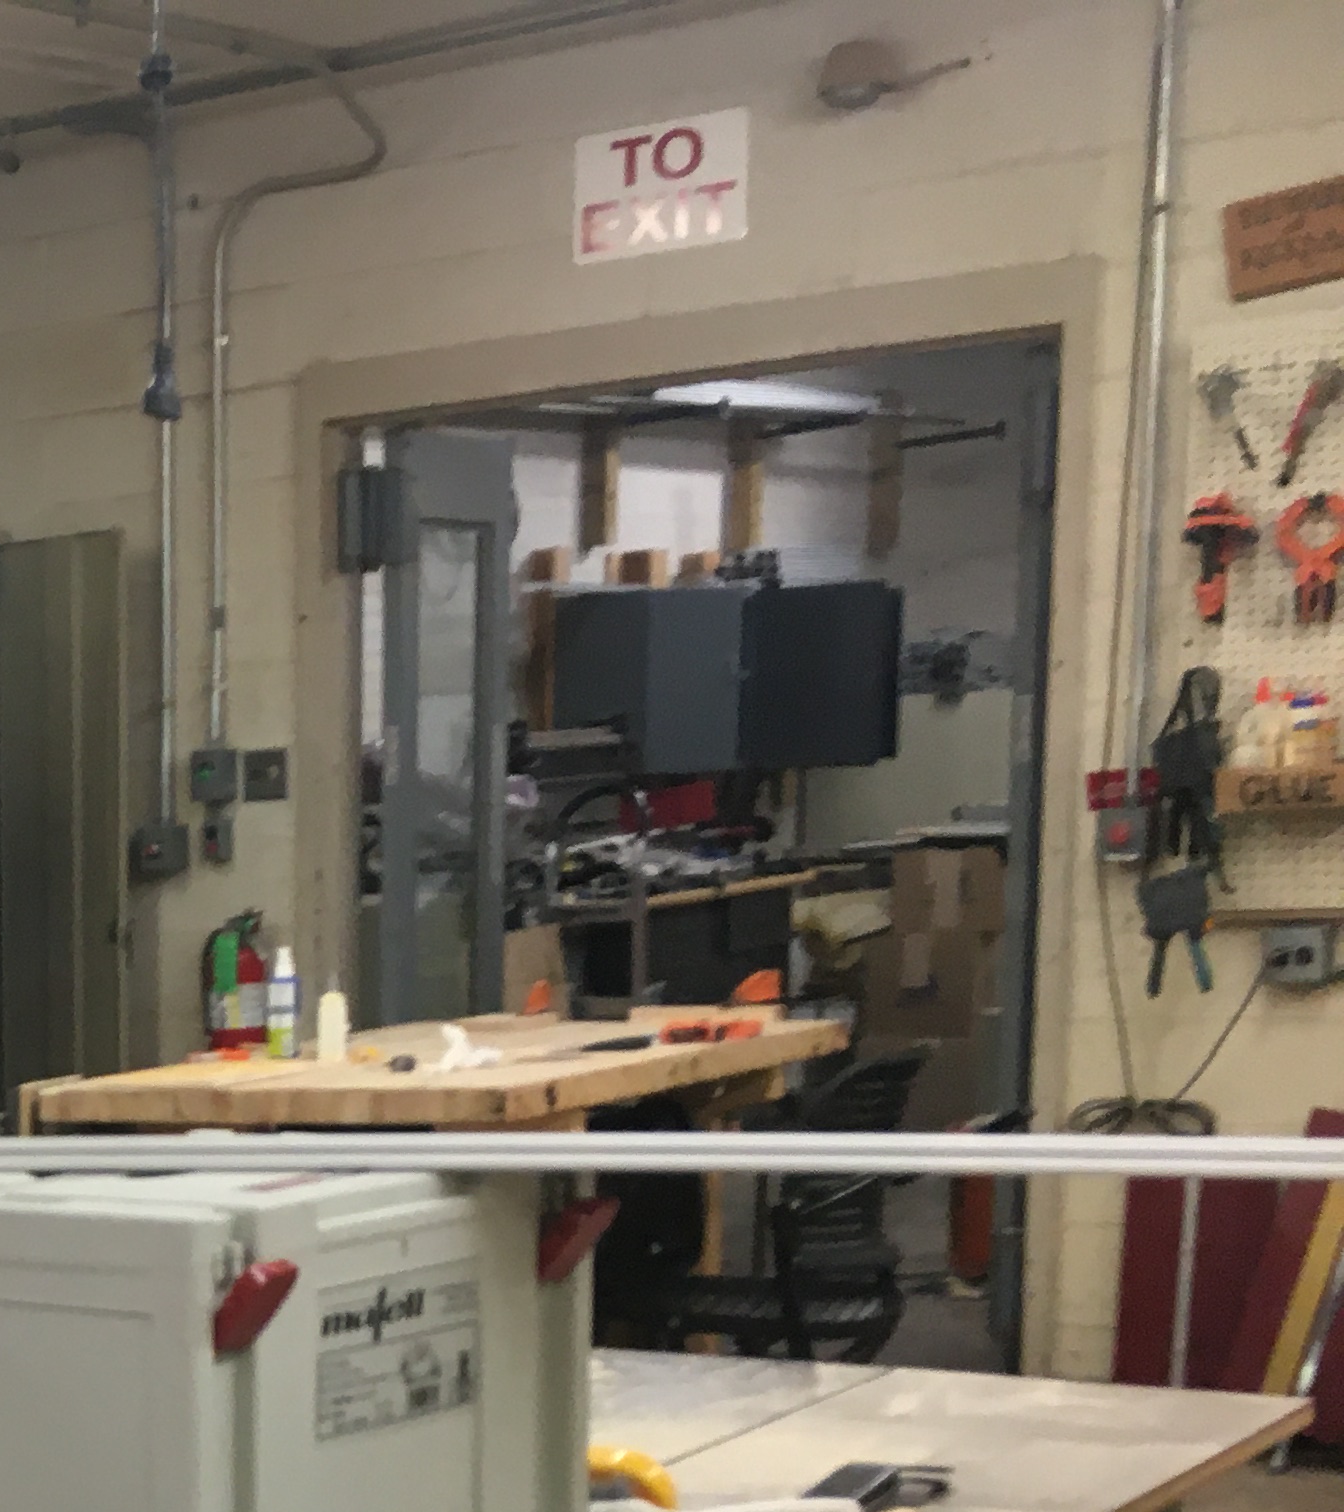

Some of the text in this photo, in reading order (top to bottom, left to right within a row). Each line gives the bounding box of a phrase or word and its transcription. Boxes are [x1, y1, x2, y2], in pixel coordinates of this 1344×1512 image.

[609, 127, 704, 187] TO
[580, 179, 737, 254] EXIT
[1238, 772, 1336, 807] GLUE
